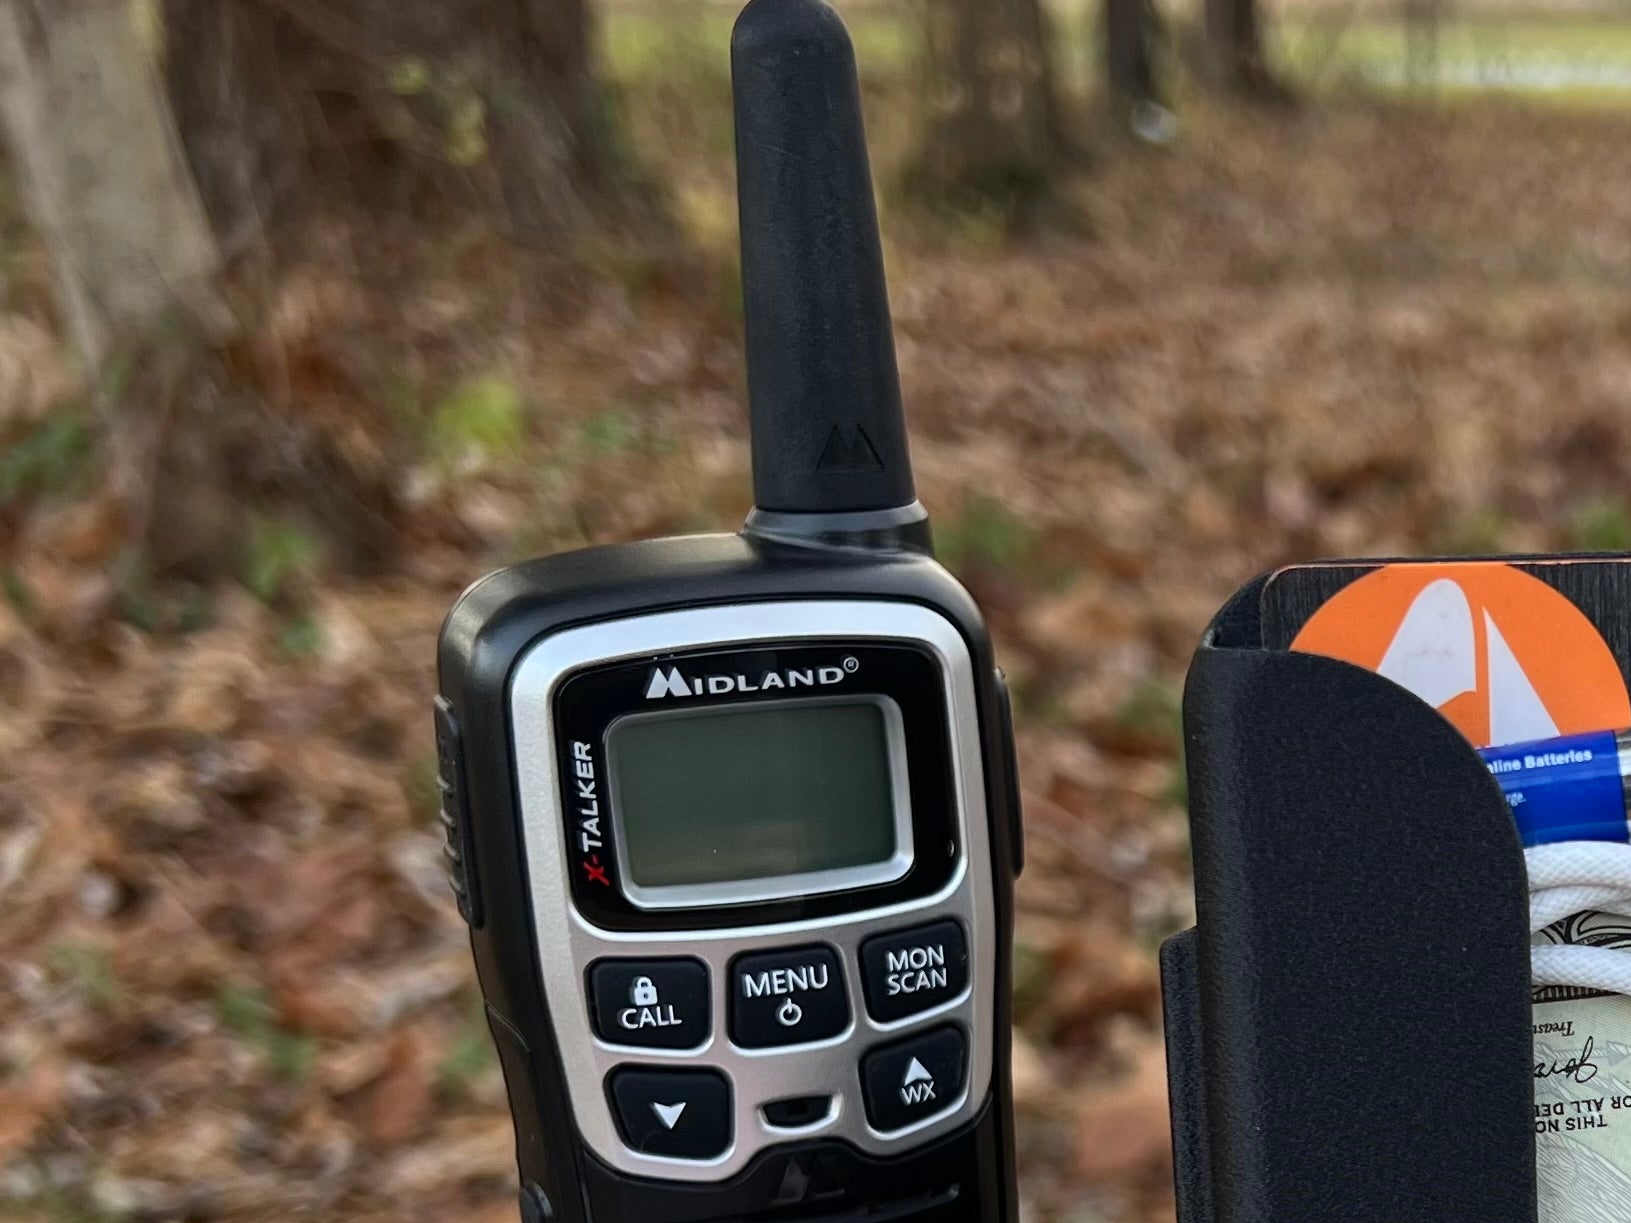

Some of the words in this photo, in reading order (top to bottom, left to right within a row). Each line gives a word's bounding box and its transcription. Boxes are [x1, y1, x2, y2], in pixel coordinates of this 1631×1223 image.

[1524, 749, 1593, 769] Batteries
[574, 741, 610, 887] X-TALKER
[887, 945, 945, 973] MON
[743, 964, 829, 998] MENU
[887, 968, 948, 996] SCAN
[621, 1005, 682, 1030] CALL
[901, 1082, 936, 1106] WX
[1570, 1098, 1604, 1114] ALL
[1566, 1113, 1608, 1131] THIS
